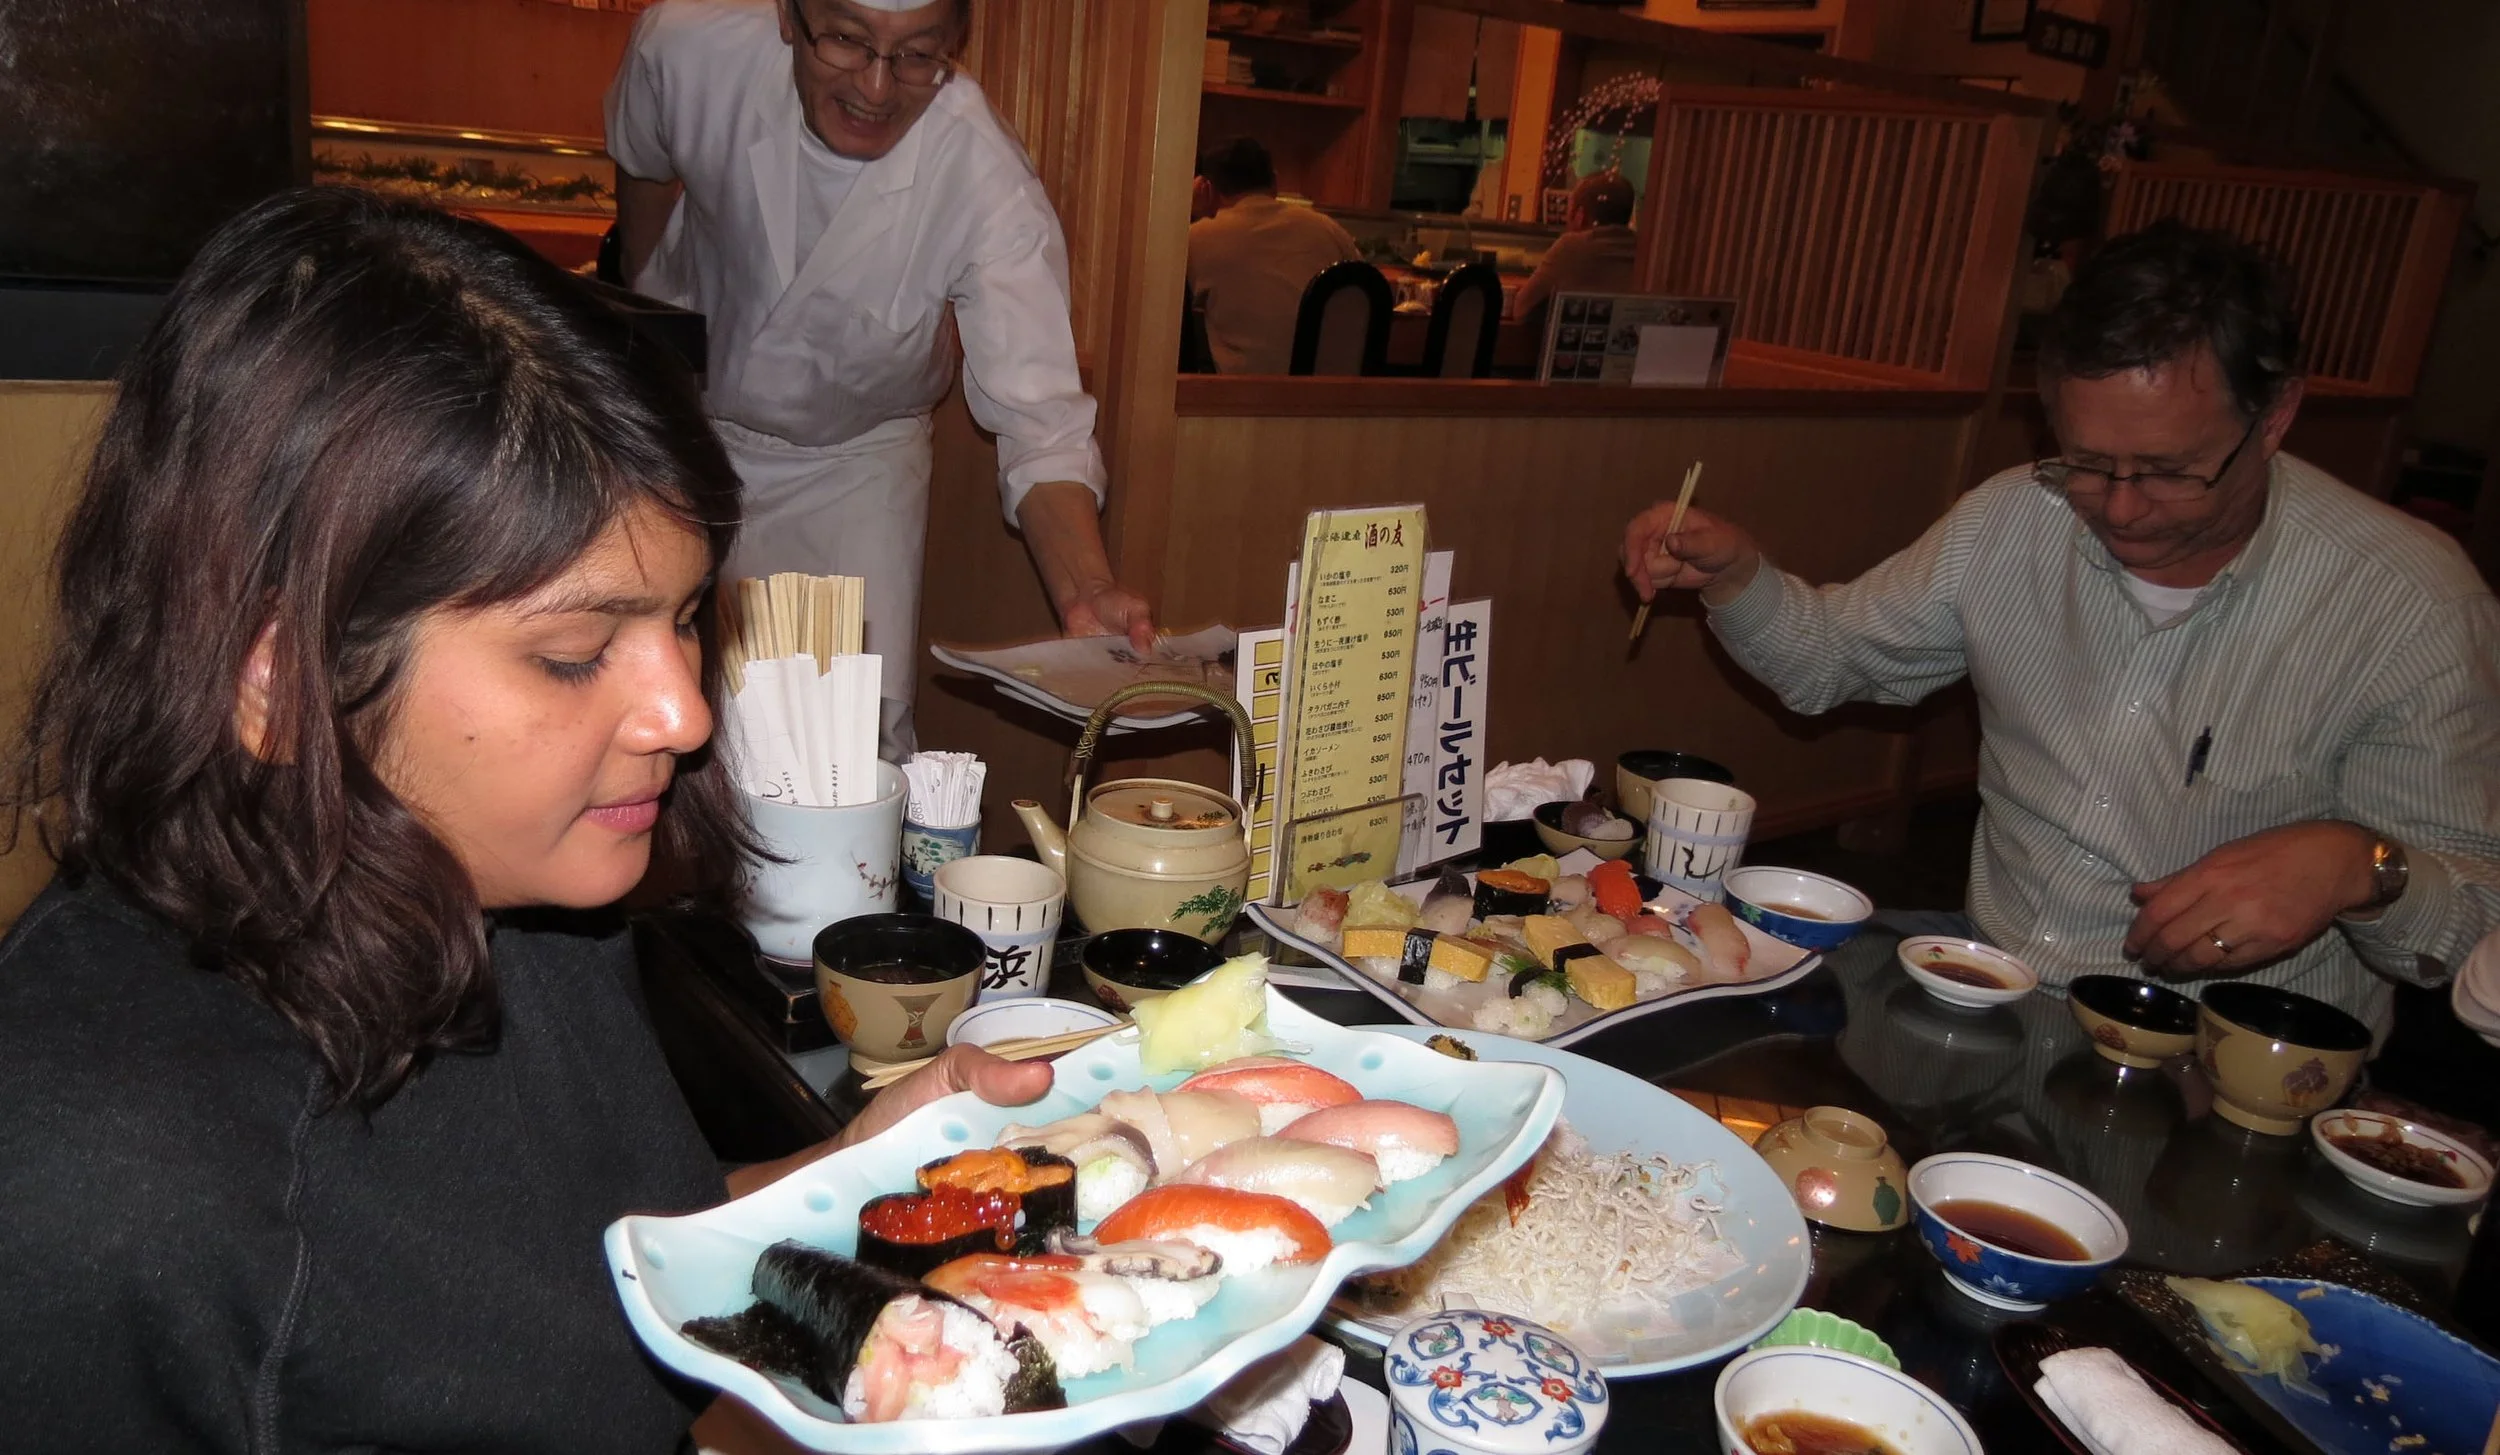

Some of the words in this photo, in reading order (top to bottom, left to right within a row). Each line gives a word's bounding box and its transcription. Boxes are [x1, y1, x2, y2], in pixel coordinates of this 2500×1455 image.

[1364, 519, 1404, 550] 酒の友
[1390, 564, 1409, 574] 320円
[1318, 594, 1337, 605] なまこ
[1388, 586, 1407, 596] 630円
[1386, 607, 1405, 617] 530円
[1383, 628, 1403, 639] 950円
[1381, 650, 1401, 660] 530円
[1379, 671, 1398, 681] 630円
[1376, 692, 1396, 702] 950円
[1374, 712, 1394, 723] 530円
[1435, 619, 1479, 845] 生ビールセット
[1303, 743, 1341, 757] イカソーメン
[1372, 733, 1392, 743] 950円
[1301, 763, 1333, 778] ふきわさび
[1370, 753, 1390, 763] 530円
[1368, 774, 1388, 785] 530円
[1368, 815, 1389, 827] 630円
